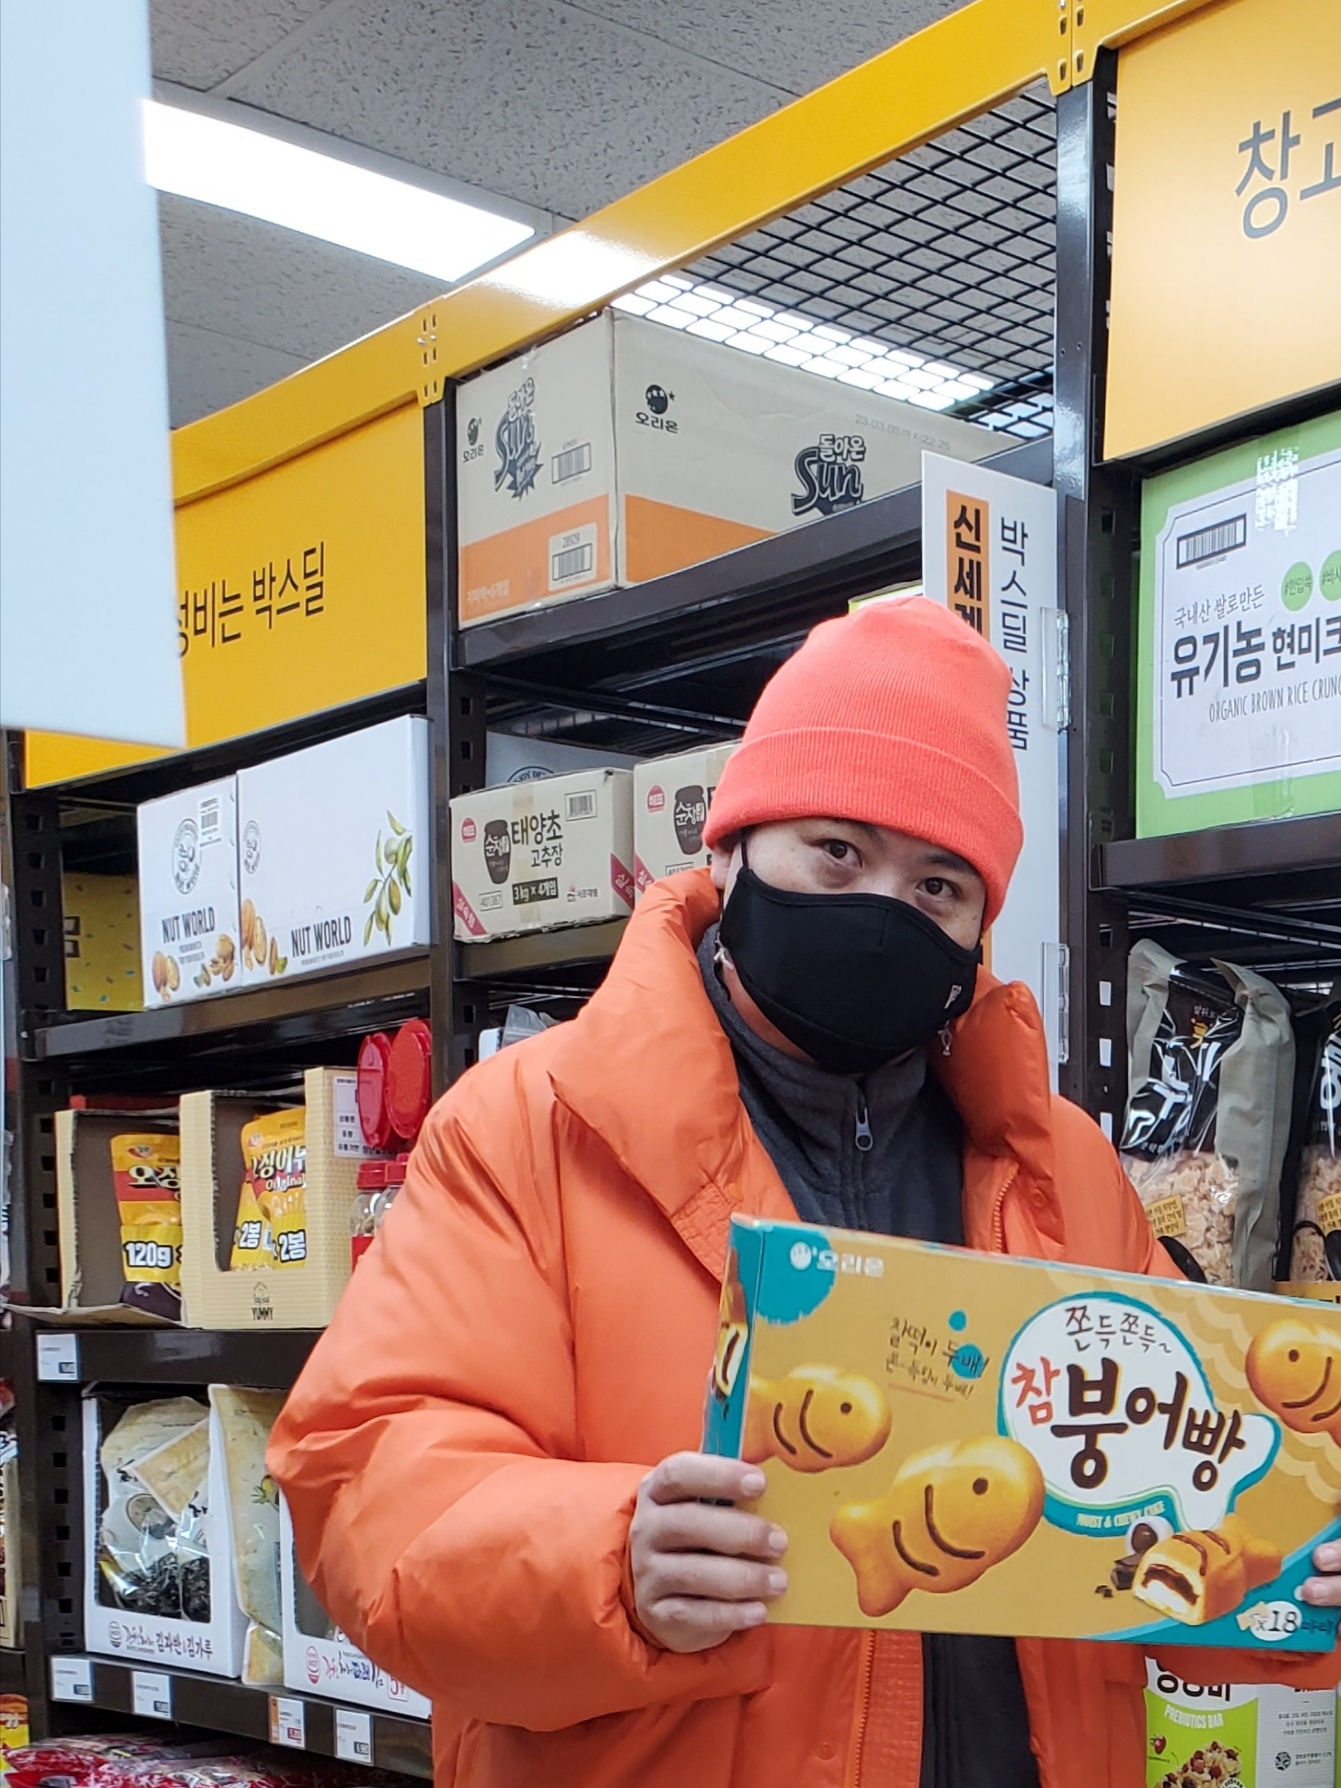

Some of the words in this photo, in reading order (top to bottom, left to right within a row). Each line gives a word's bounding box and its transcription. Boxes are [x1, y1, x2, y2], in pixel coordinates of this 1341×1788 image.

[634, 411, 679, 434] 오리온
[462, 444, 484, 463] 오리온
[818, 434, 867, 462] 돌아온
[251, 541, 327, 630] 박스딜
[1000, 516, 1029, 654] 박스딜
[1173, 599, 1212, 628] 국내산
[1213, 584, 1266, 621] 쌀로만든
[1171, 620, 1266, 699] 유기농
[1209, 694, 1247, 723] ORGANIC
[1251, 687, 1284, 713] BROWN
[1287, 681, 1308, 706] RICE
[511, 809, 563, 845] 태양초
[531, 844, 564, 868] 고추장
[162, 916, 179, 944] NUT
[182, 907, 216, 938] WORLD
[291, 928, 311, 957] NUT
[315, 916, 351, 950] WORLD
[125, 1241, 174, 1268] 120g
[278, 1231, 306, 1263] 2봉
[816, 1250, 885, 1279] 오리온
[251, 1307, 273, 1320] YUMMY
[1010, 1356, 1062, 1426] 참
[1050, 1357, 1247, 1493] 붕어빵
[1164, 1704, 1207, 1730] PREBIOTICS
[1208, 1712, 1224, 1729] BAR
